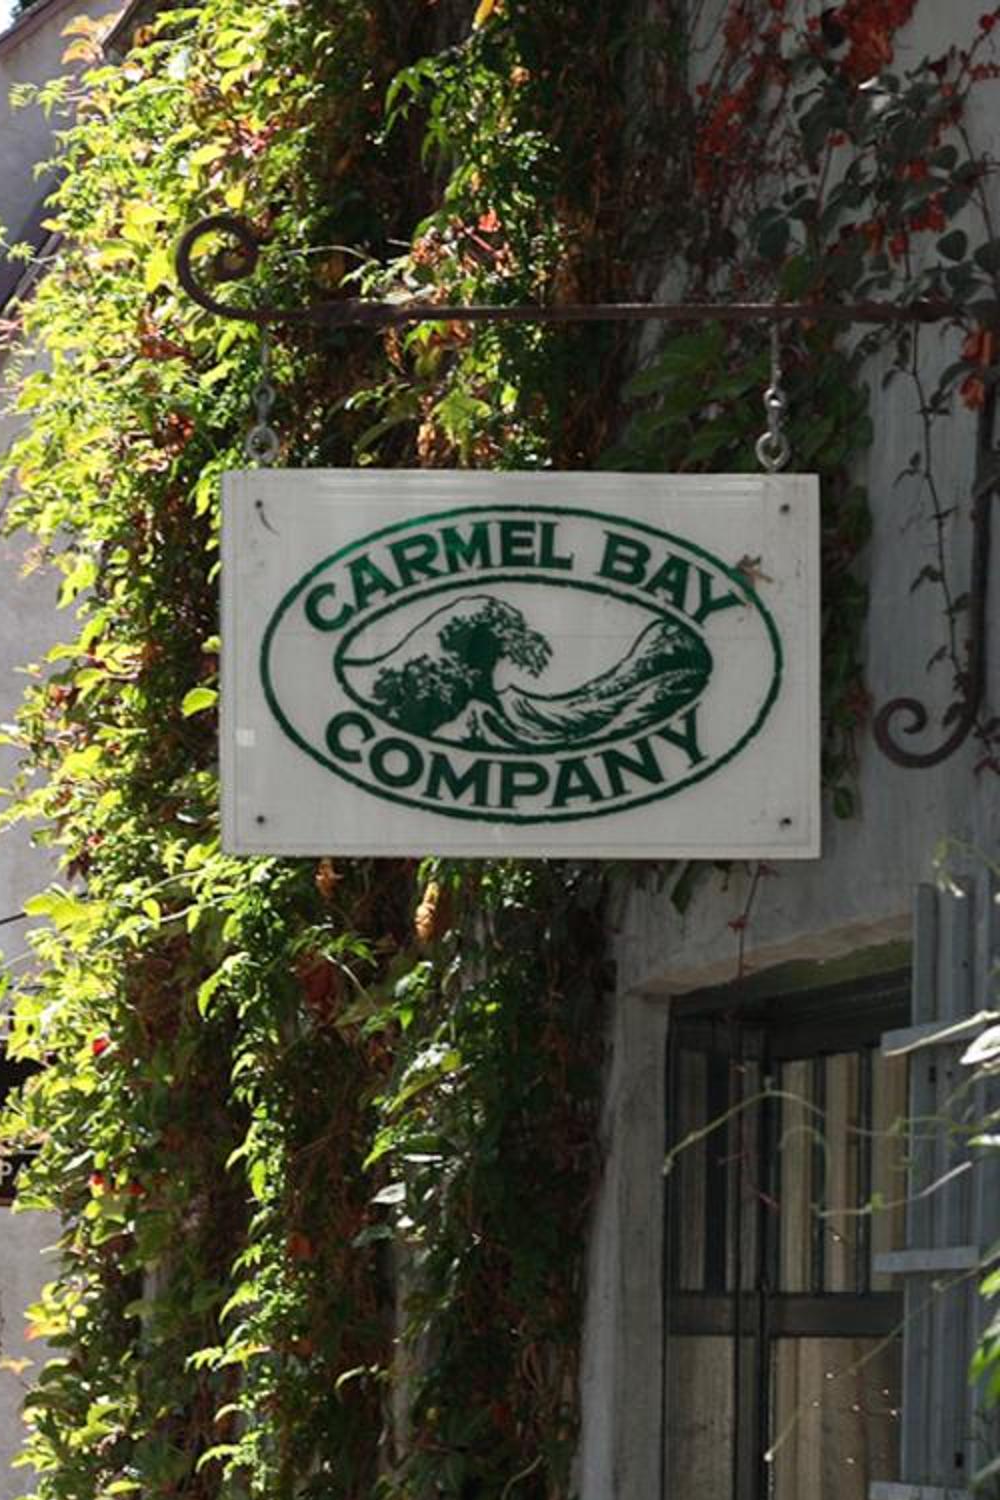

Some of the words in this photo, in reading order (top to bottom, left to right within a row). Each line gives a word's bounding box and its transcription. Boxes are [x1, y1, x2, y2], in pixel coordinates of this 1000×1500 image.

[304, 520, 573, 632] CARMEL
[596, 531, 742, 626] BAY
[325, 706, 707, 809] COMPANY
